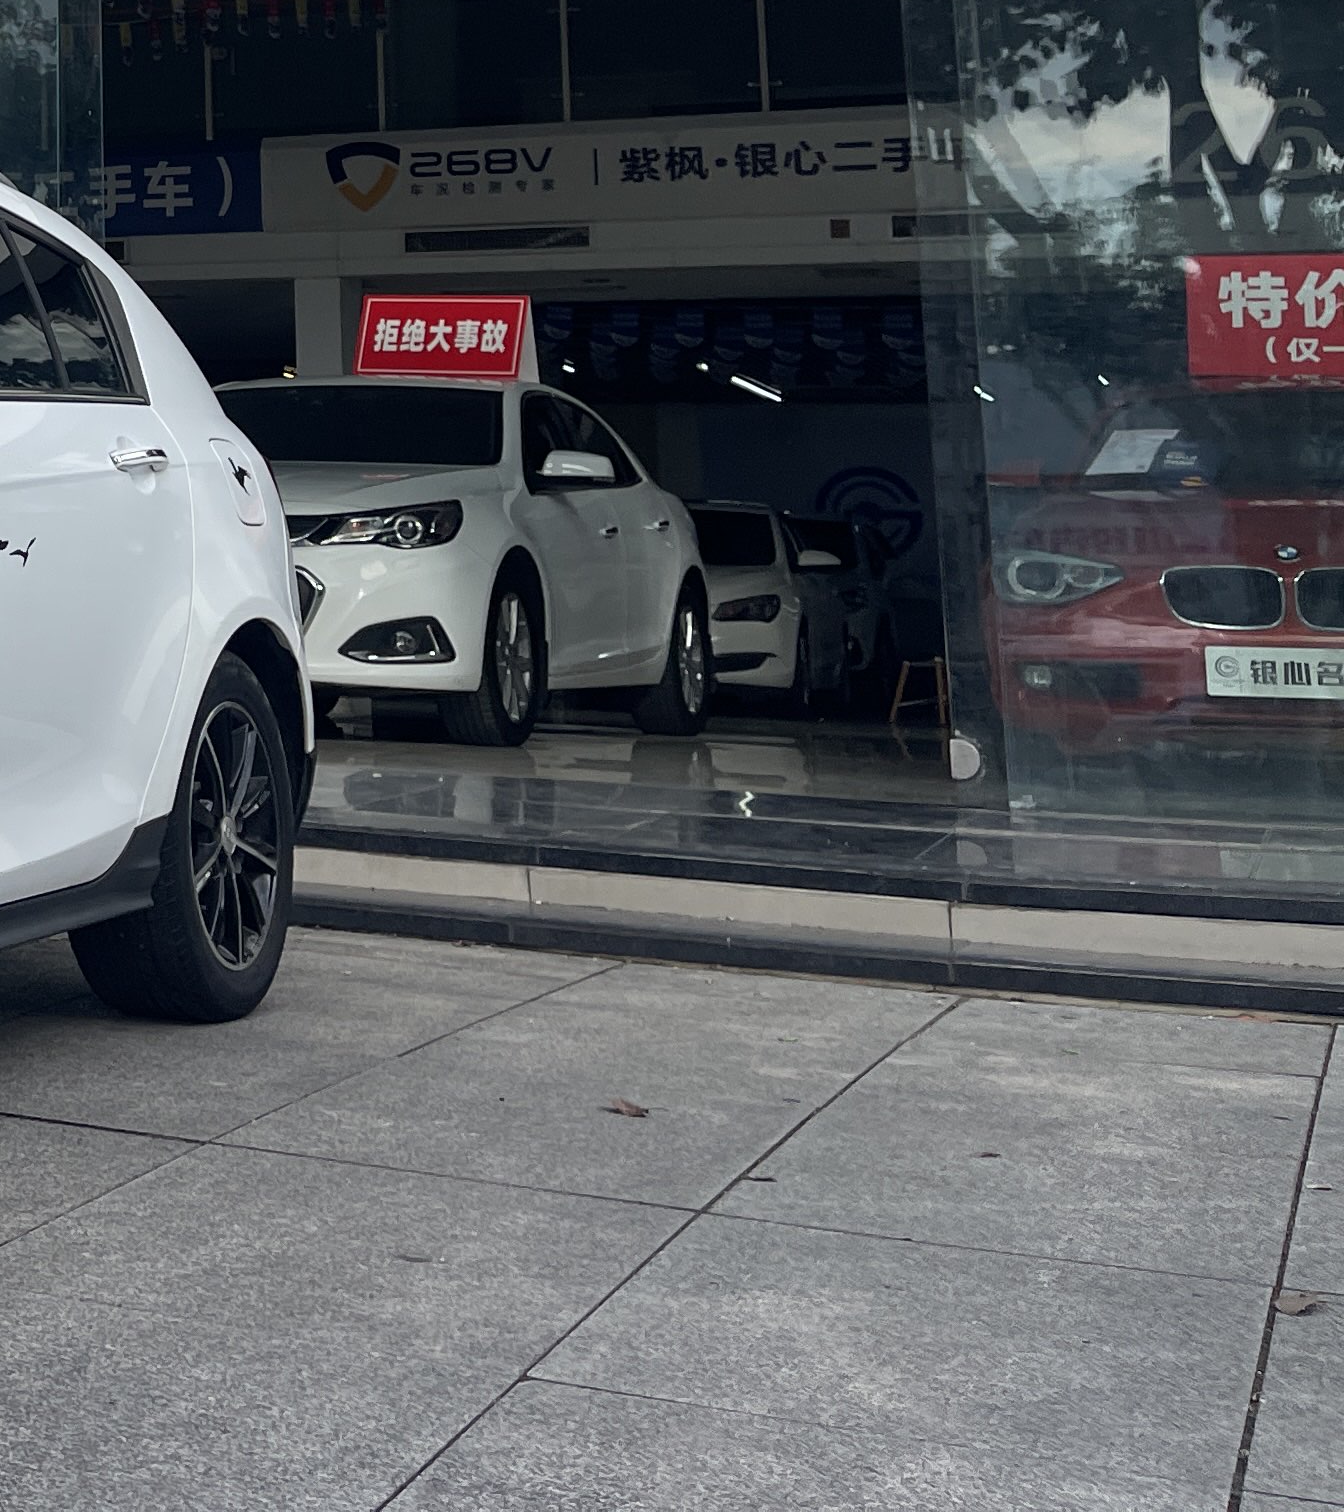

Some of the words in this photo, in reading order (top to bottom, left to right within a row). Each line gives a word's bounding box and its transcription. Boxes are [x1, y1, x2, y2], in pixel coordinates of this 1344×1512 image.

[409, 146, 553, 178] 268V
[1217, 268, 1344, 329] 特价
[373, 318, 509, 355] 拒绝大事故
